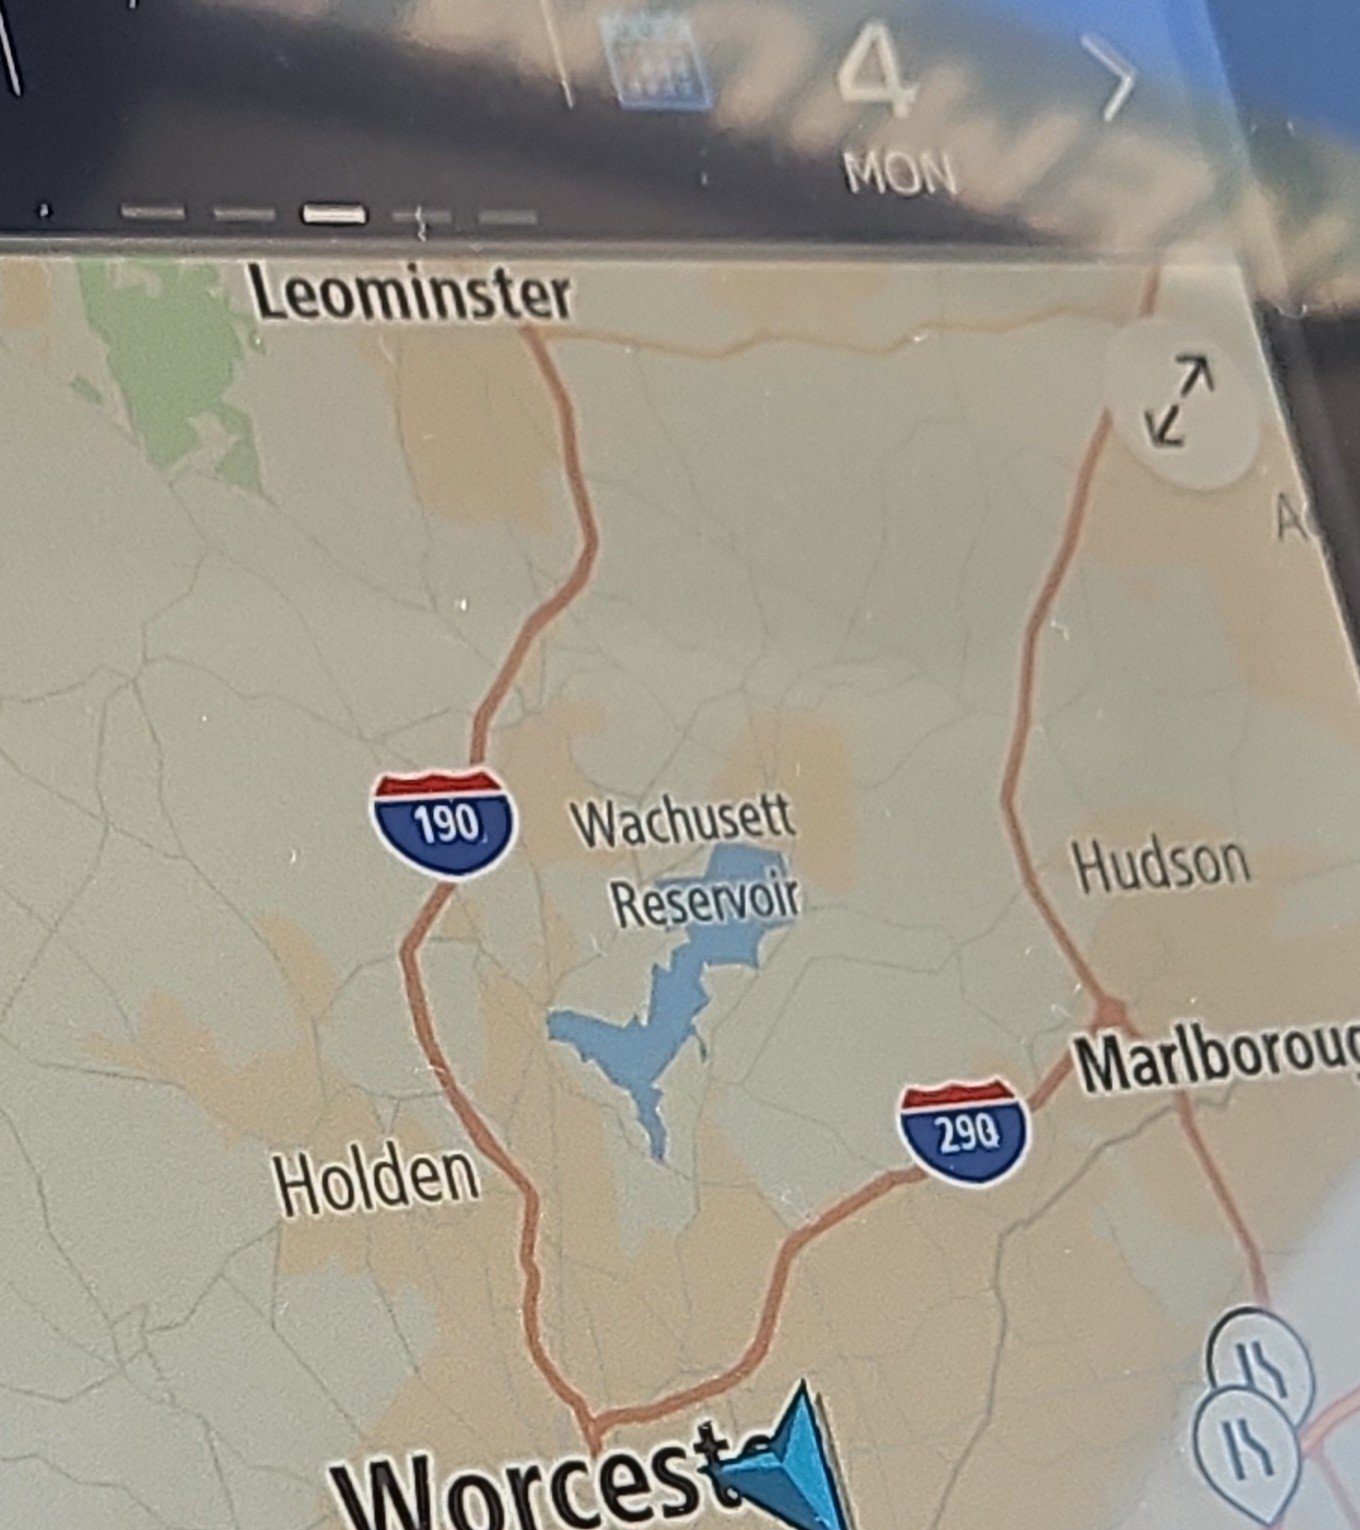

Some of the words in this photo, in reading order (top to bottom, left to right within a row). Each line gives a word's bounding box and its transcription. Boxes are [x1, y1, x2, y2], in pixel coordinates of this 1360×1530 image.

[839, 20, 917, 118] 4
[843, 149, 959, 196] MON
[247, 263, 573, 322] Leominster
[414, 803, 480, 846] 190
[571, 793, 797, 849] Wachusett
[1072, 833, 1251, 895] Hudson
[611, 874, 802, 930] Reservoir
[935, 1112, 1001, 1155] 290
[274, 1142, 480, 1218] Holden
